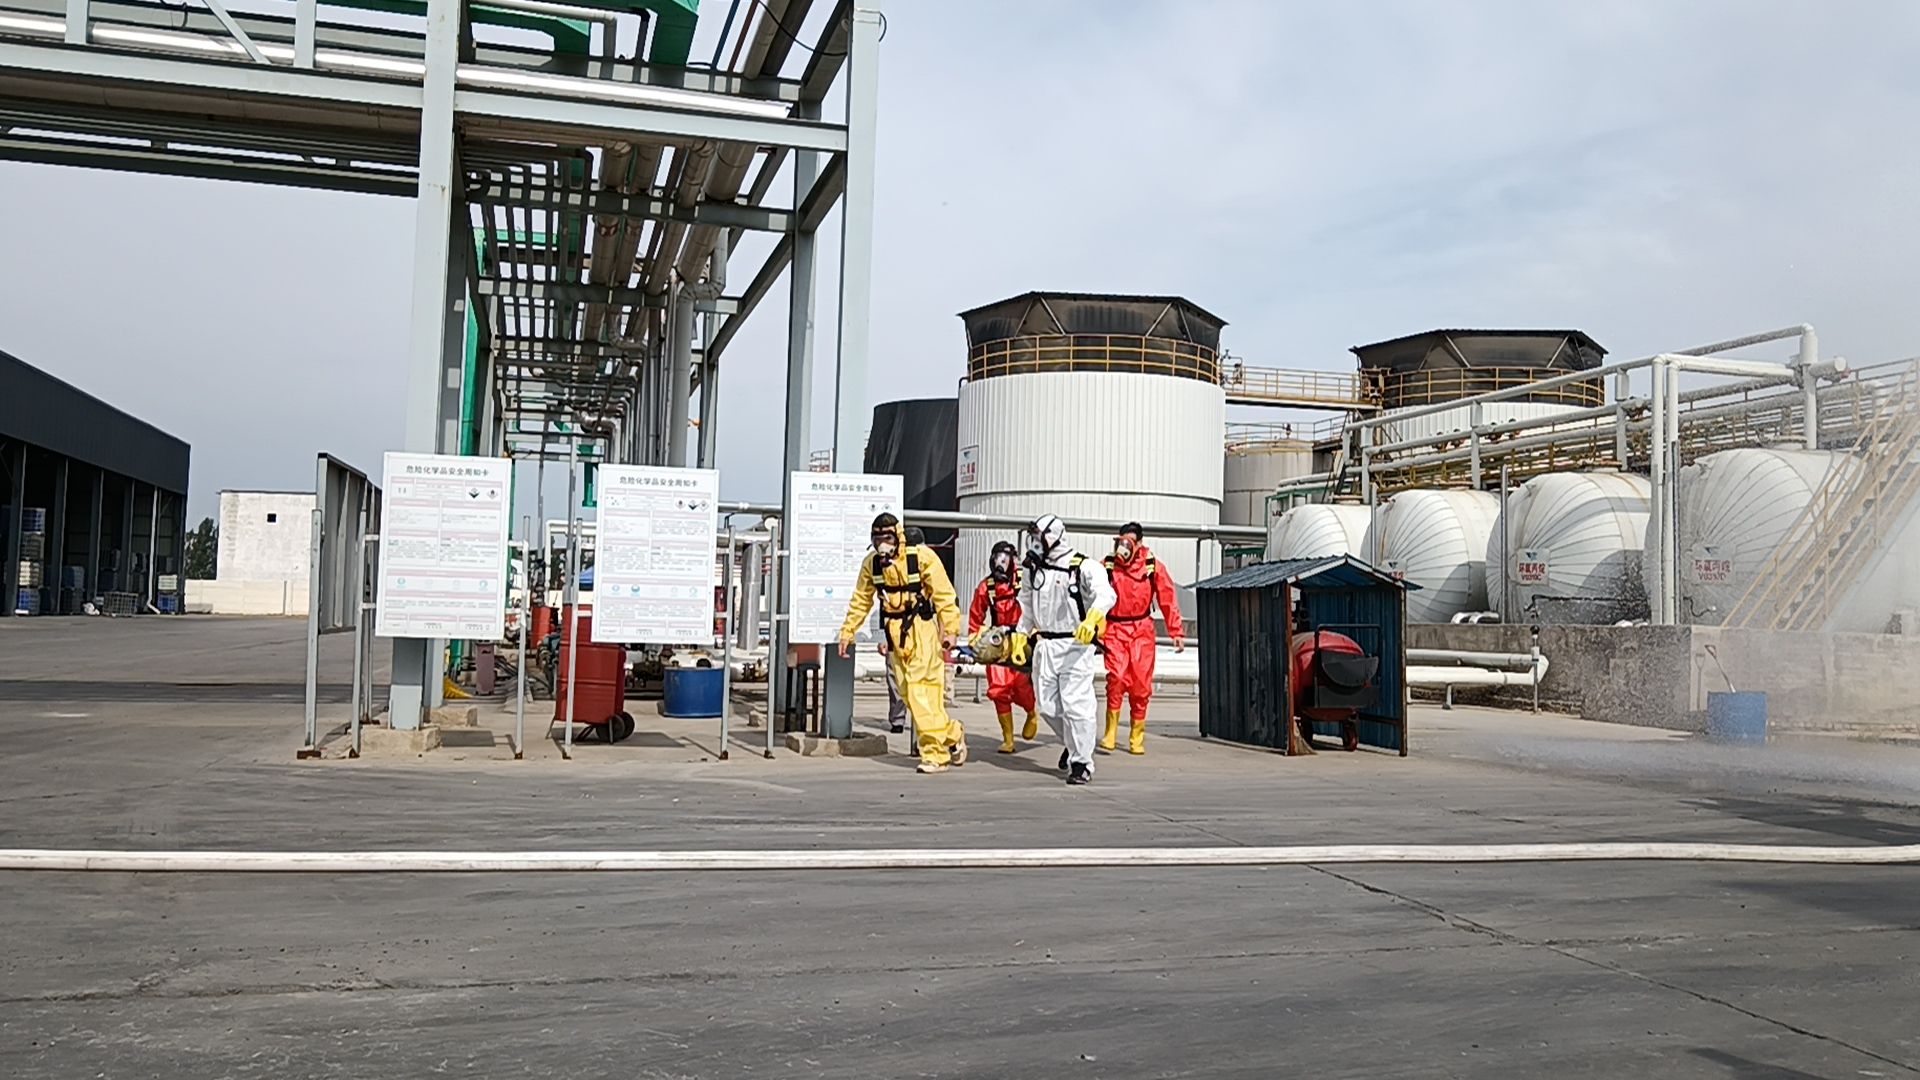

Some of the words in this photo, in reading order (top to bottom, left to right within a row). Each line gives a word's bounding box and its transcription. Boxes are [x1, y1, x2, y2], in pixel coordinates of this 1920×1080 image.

[405, 464, 490, 477] 危险化学品安全周知卡
[619, 476, 698, 487] 危险化学品安全周知卡
[811, 483, 884, 493] 危险化学品安全周知卡
